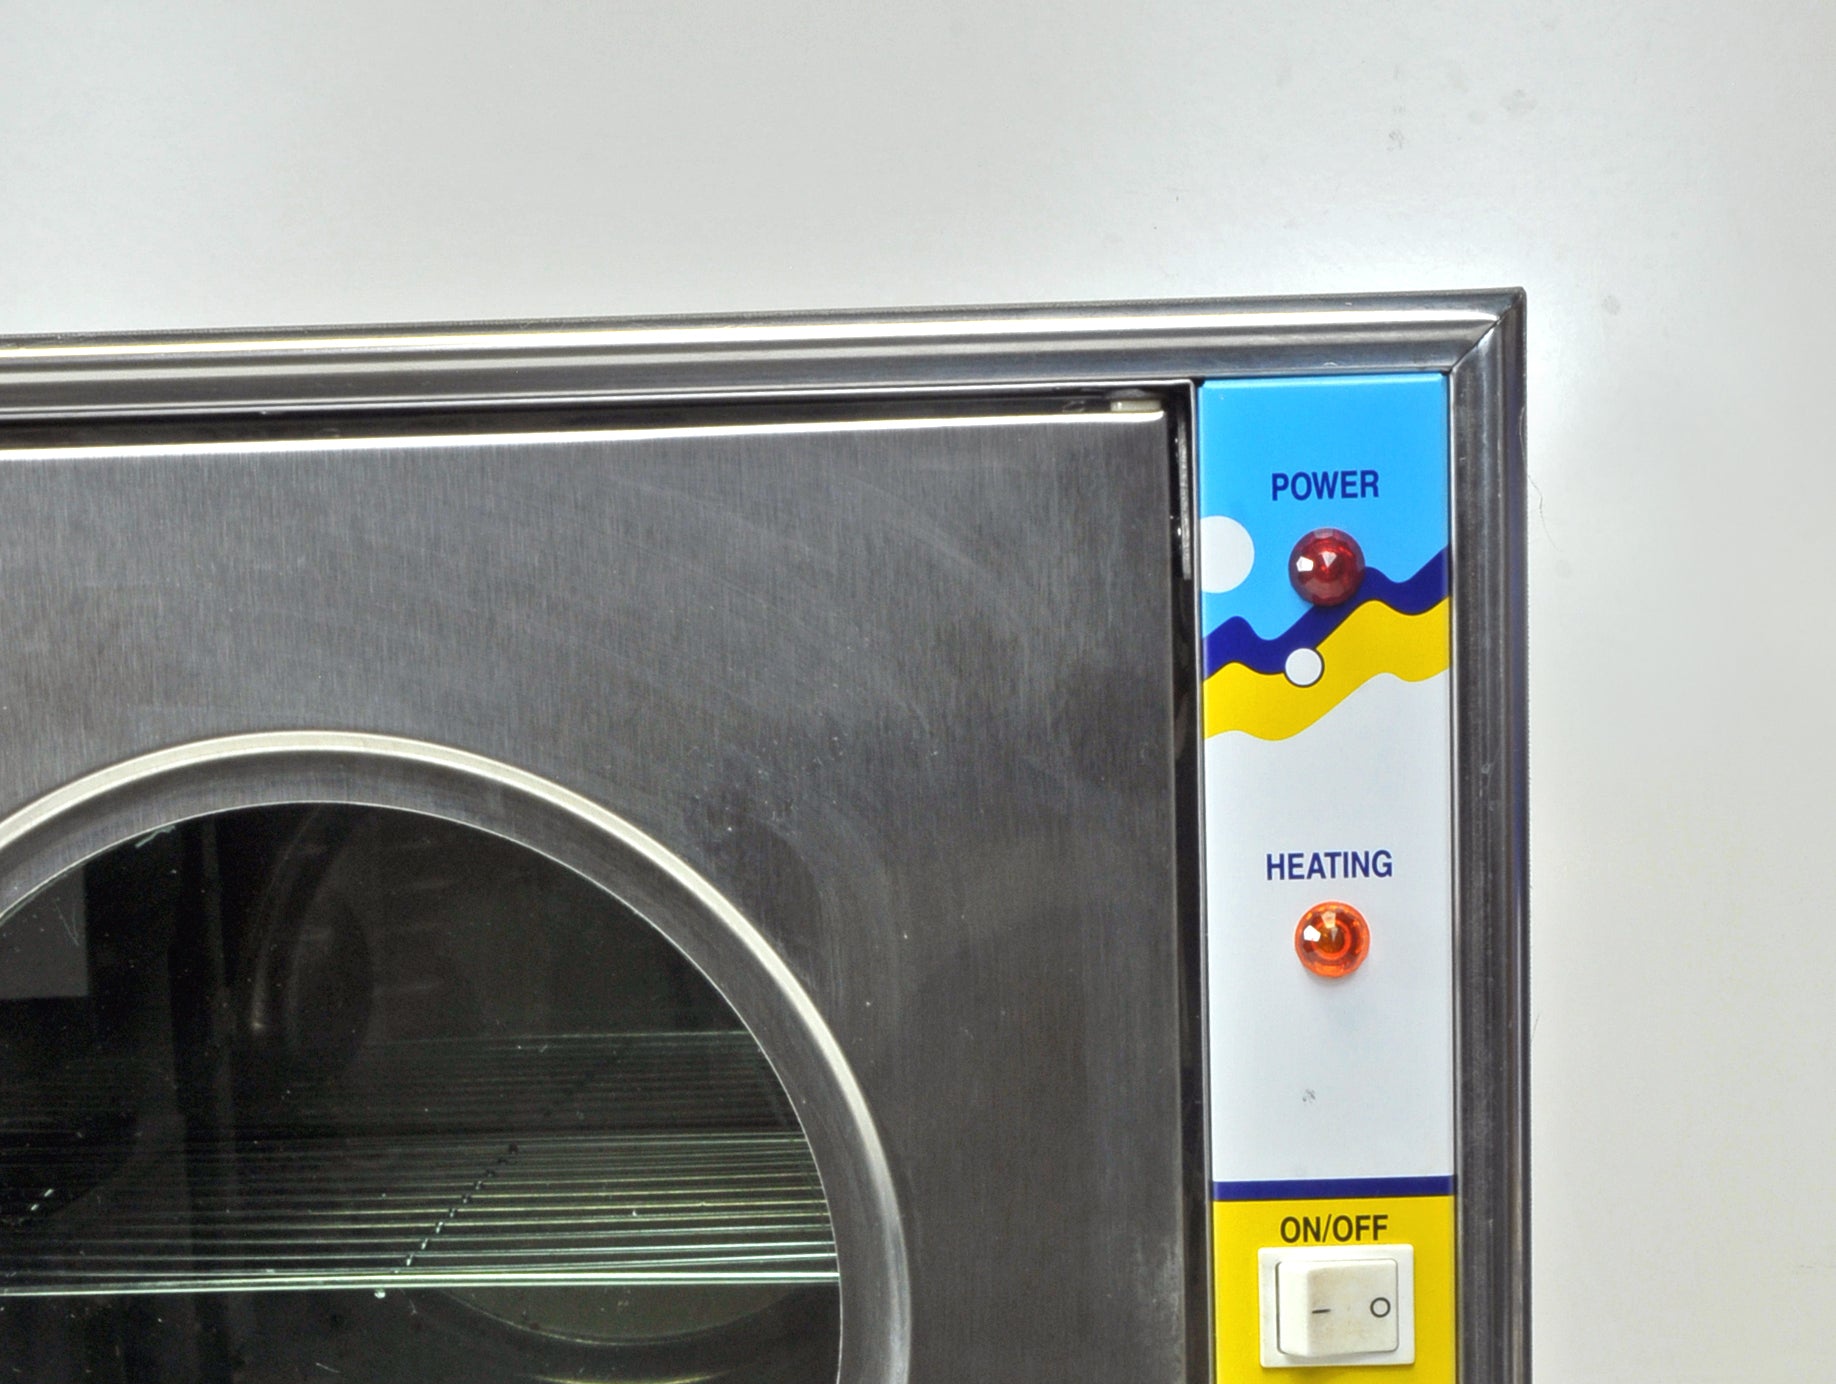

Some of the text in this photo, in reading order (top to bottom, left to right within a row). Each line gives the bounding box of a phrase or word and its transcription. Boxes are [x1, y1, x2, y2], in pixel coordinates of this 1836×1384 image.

[1271, 469, 1380, 501] POWER
[1265, 849, 1394, 881] HEATING
[1280, 1213, 1389, 1244] ON/OFF
